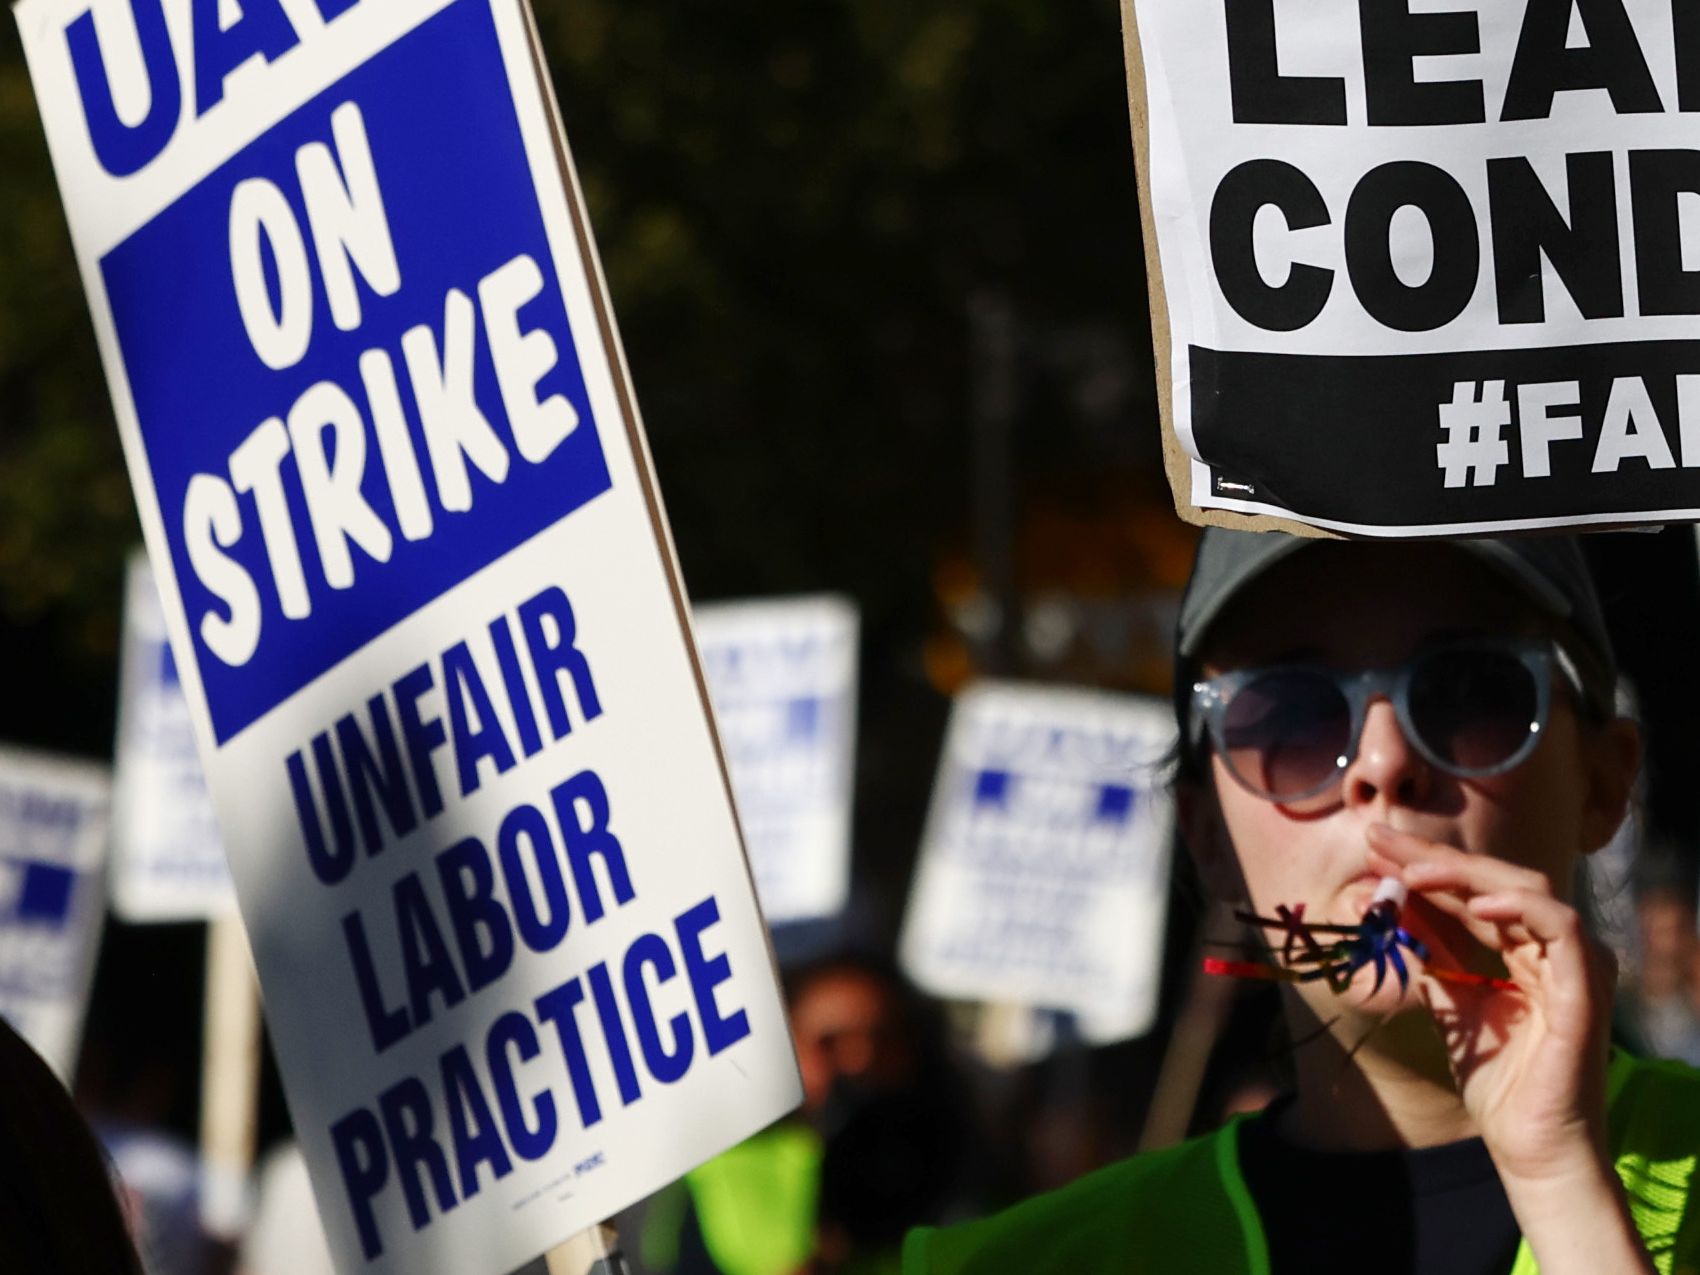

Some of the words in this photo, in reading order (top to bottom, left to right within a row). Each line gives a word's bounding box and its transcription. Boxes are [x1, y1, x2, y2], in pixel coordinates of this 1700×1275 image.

[229, 101, 401, 370] ON
[183, 254, 579, 666] STRIKE
[285, 585, 603, 885] UNFAIR
[342, 770, 636, 1055] LABOR
[330, 895, 752, 1262] PRACTICE
